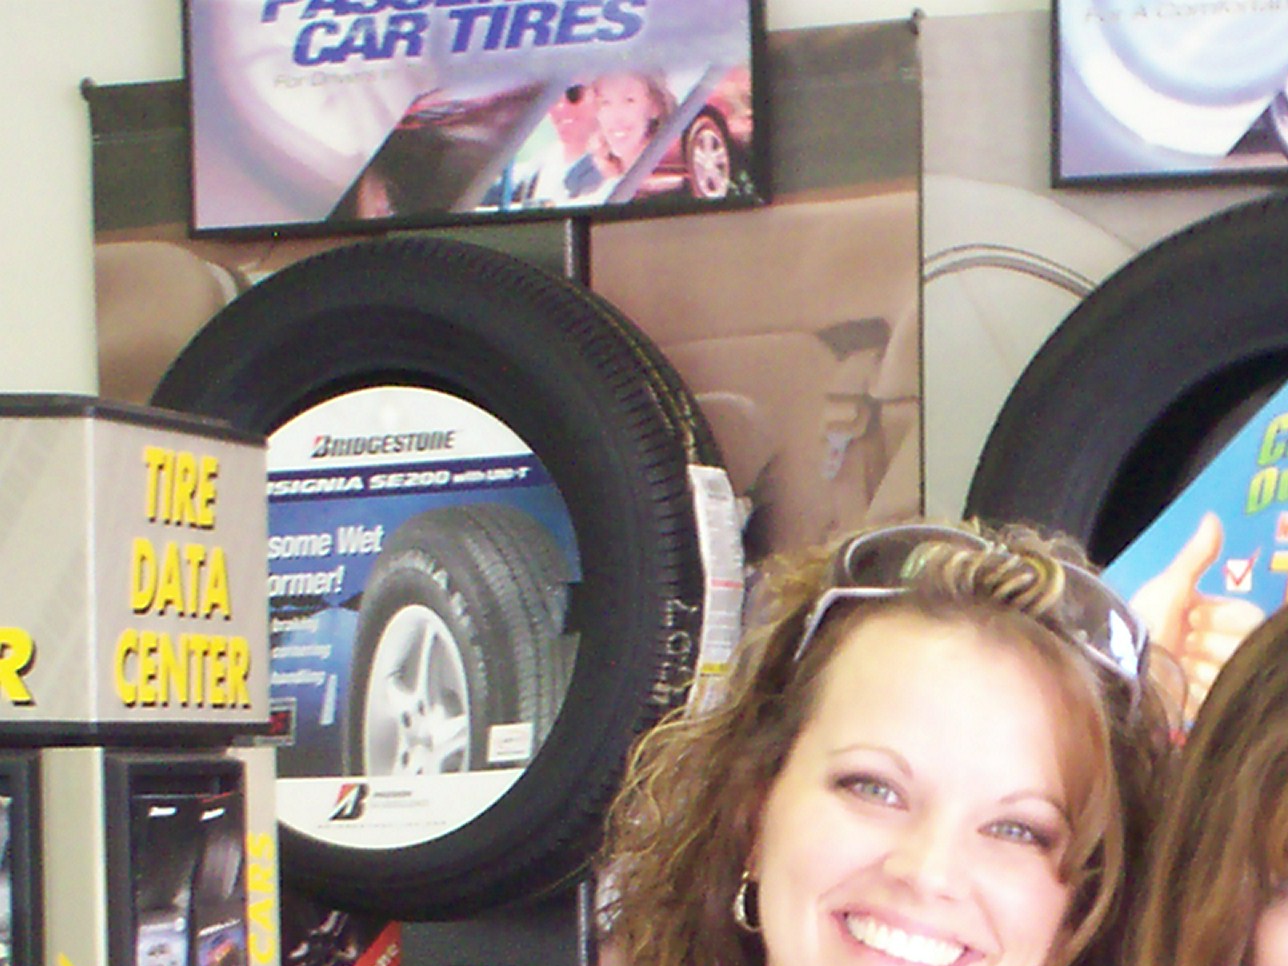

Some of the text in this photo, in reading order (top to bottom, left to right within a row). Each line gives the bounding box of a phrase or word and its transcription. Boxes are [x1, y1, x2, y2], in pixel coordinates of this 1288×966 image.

[293, 11, 431, 67] CAR
[449, 1, 646, 54] TIRES
[310, 430, 458, 459] BRIDGESTONE
[369, 470, 451, 490] SE200
[144, 445, 218, 529] TIRE
[130, 536, 232, 620] DATA
[268, 524, 384, 559] some Wet
[113, 628, 251, 708] CENTER
[246, 832, 276, 965] CARS
